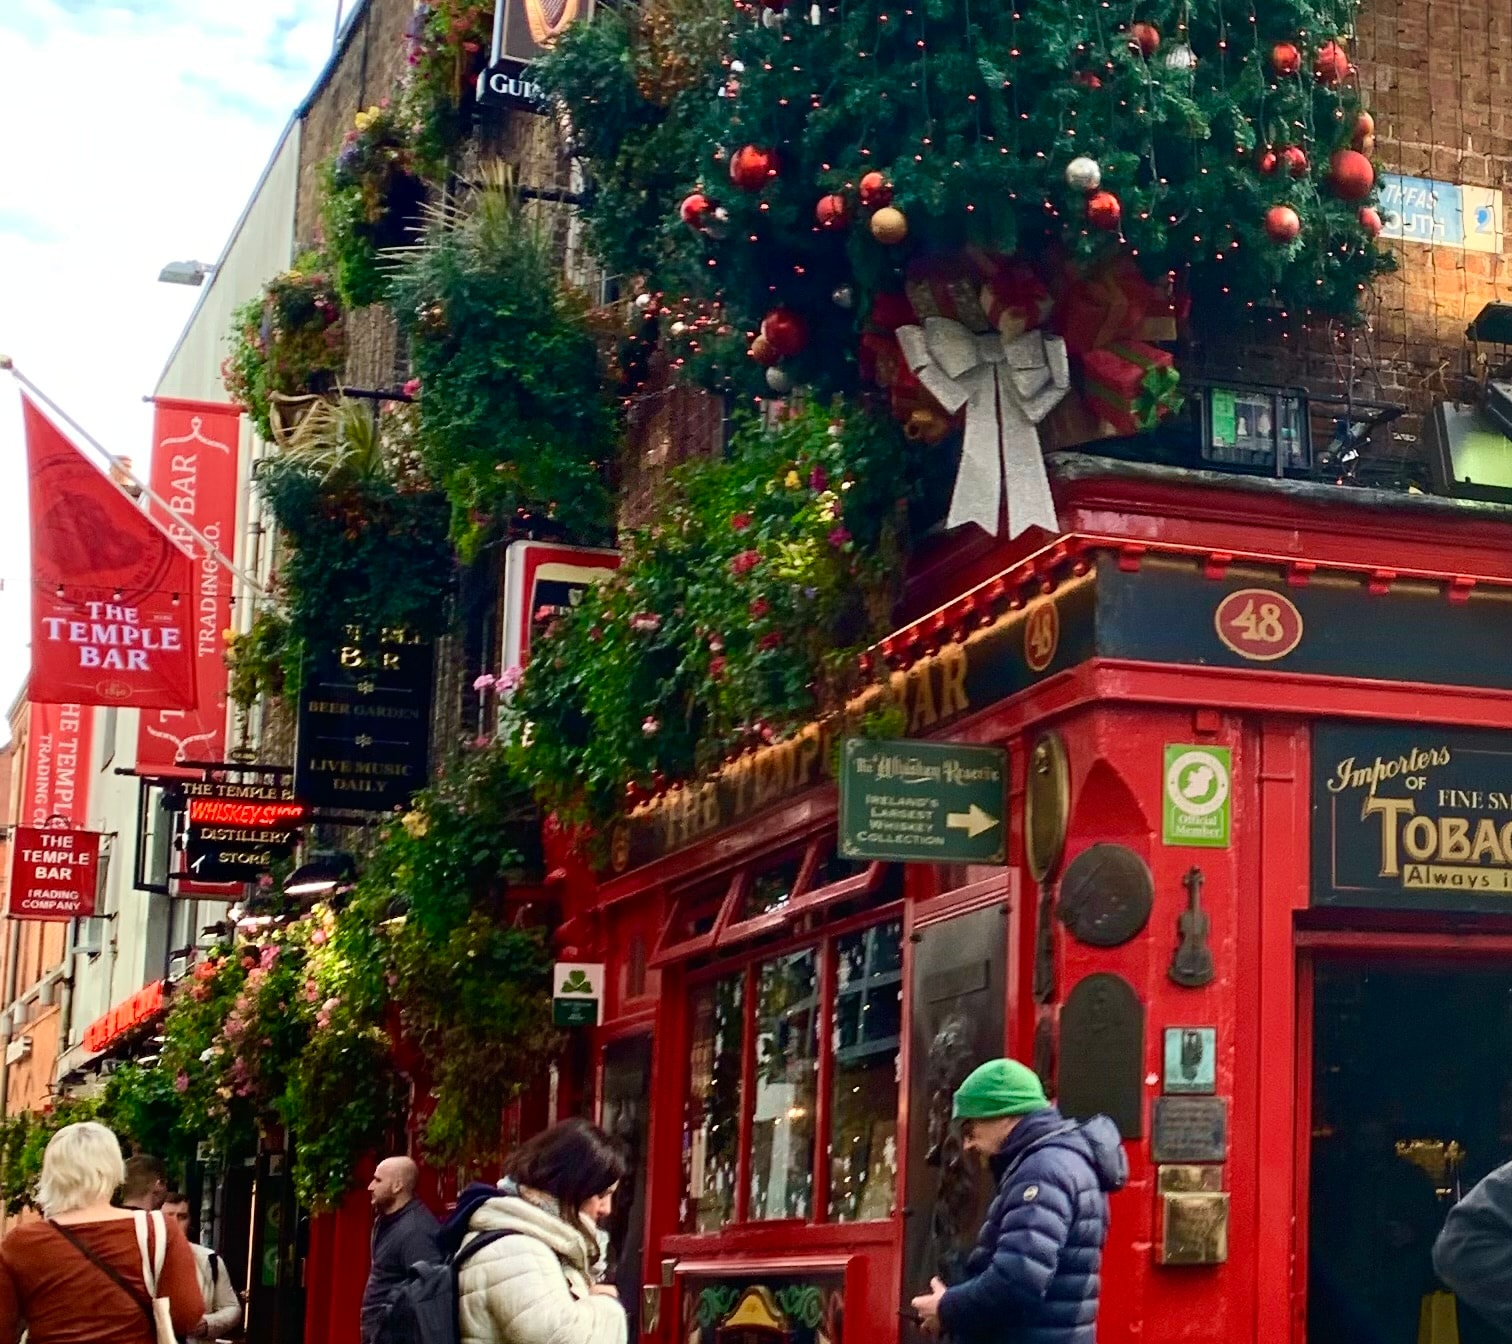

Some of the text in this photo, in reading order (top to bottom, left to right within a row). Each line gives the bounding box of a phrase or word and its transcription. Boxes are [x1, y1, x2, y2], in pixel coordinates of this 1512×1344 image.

[1384, 210, 1445, 236] OUTH
[170, 454, 197, 515] BAR
[86, 601, 139, 624] THE
[198, 558, 219, 657] TRADING
[1230, 599, 1284, 642] 48
[42, 617, 181, 650] TEMPLE
[80, 646, 150, 671] BAR
[340, 646, 401, 670] BR
[60, 704, 81, 733] HE
[308, 701, 420, 719] BEER GARDEN
[35, 733, 52, 804] TRADING
[310, 758, 413, 777] LIVE MUSIC
[1327, 745, 1451, 795] Importers
[53, 738, 78, 826] TEMPL
[182, 782, 213, 795] THE
[216, 785, 277, 800] TEMPLE
[333, 778, 387, 792] DAILY
[1405, 776, 1427, 790] OF
[1439, 789, 1484, 808] FINE
[191, 800, 261, 823] WHISKEY
[40, 835, 73, 848] THE
[200, 828, 290, 843] DISTILLERY
[856, 831, 945, 845] COLLECTION
[22, 849, 89, 865] TEMPLE
[218, 851, 271, 864] STORE
[35, 867, 72, 880] BAR
[1407, 866, 1490, 888] Always
[22, 900, 81, 911] COMPANY
